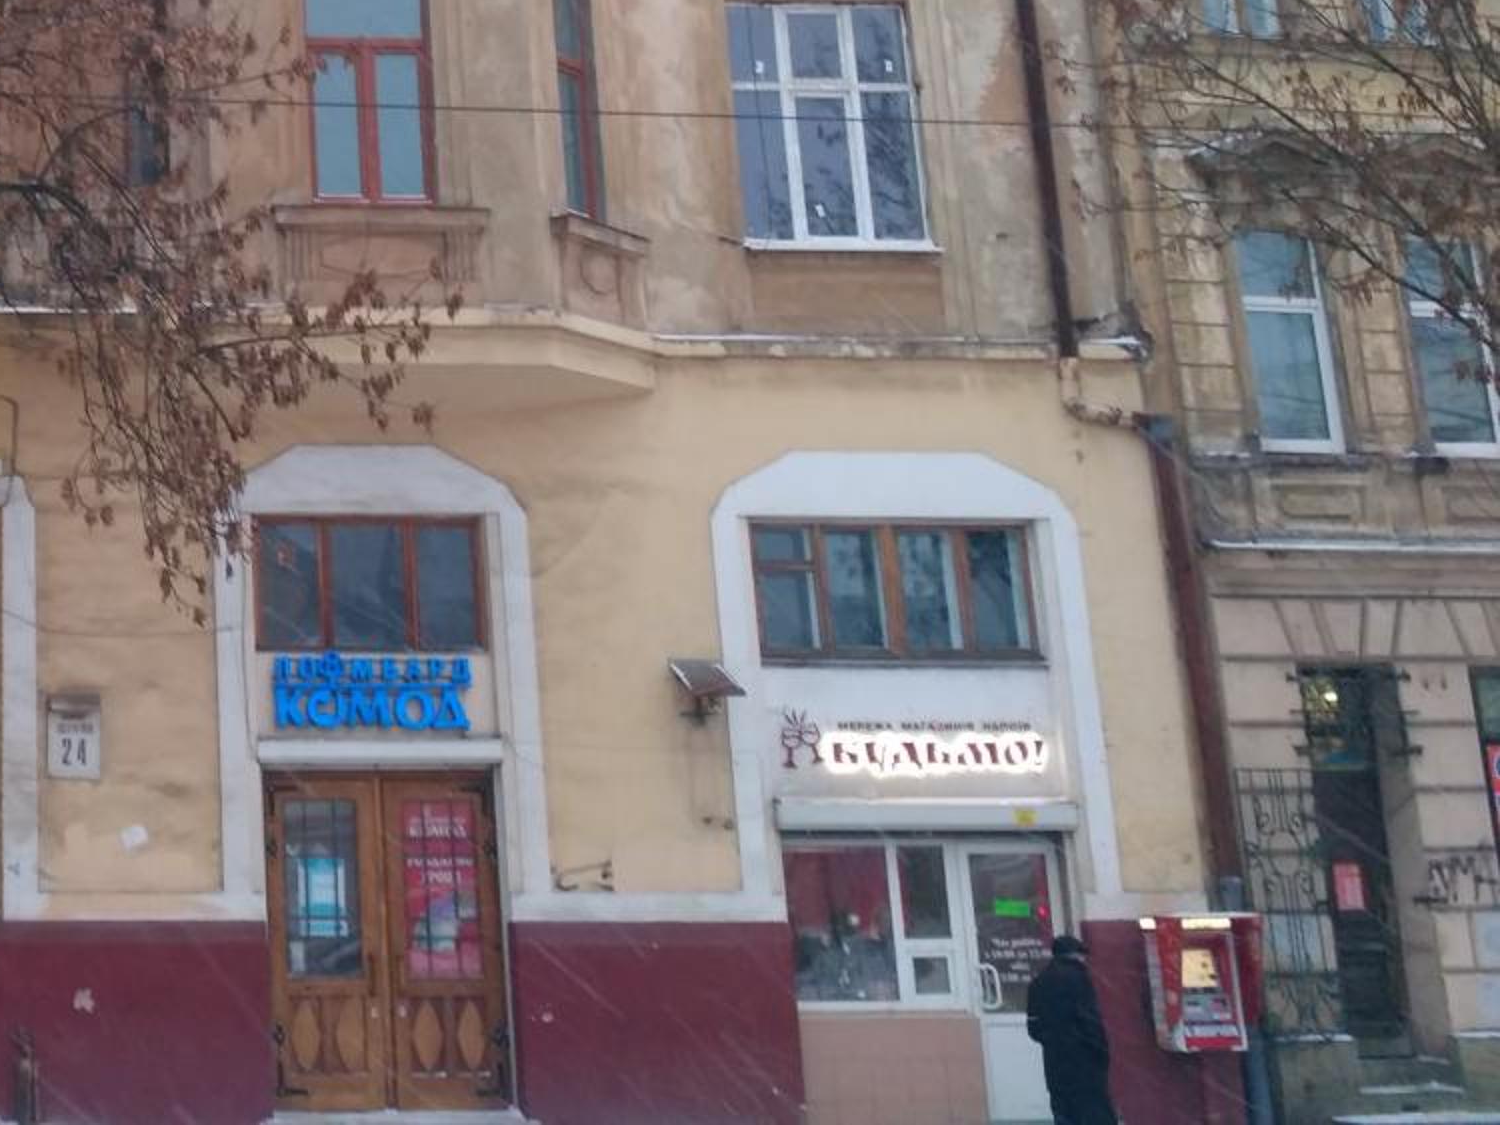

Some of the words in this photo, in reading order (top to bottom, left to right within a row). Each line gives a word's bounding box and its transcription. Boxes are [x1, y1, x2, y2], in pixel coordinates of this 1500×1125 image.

[275, 684, 472, 730] КОМОД
[61, 737, 86, 766] 24
[829, 737, 1045, 774] БУДЬМО!
